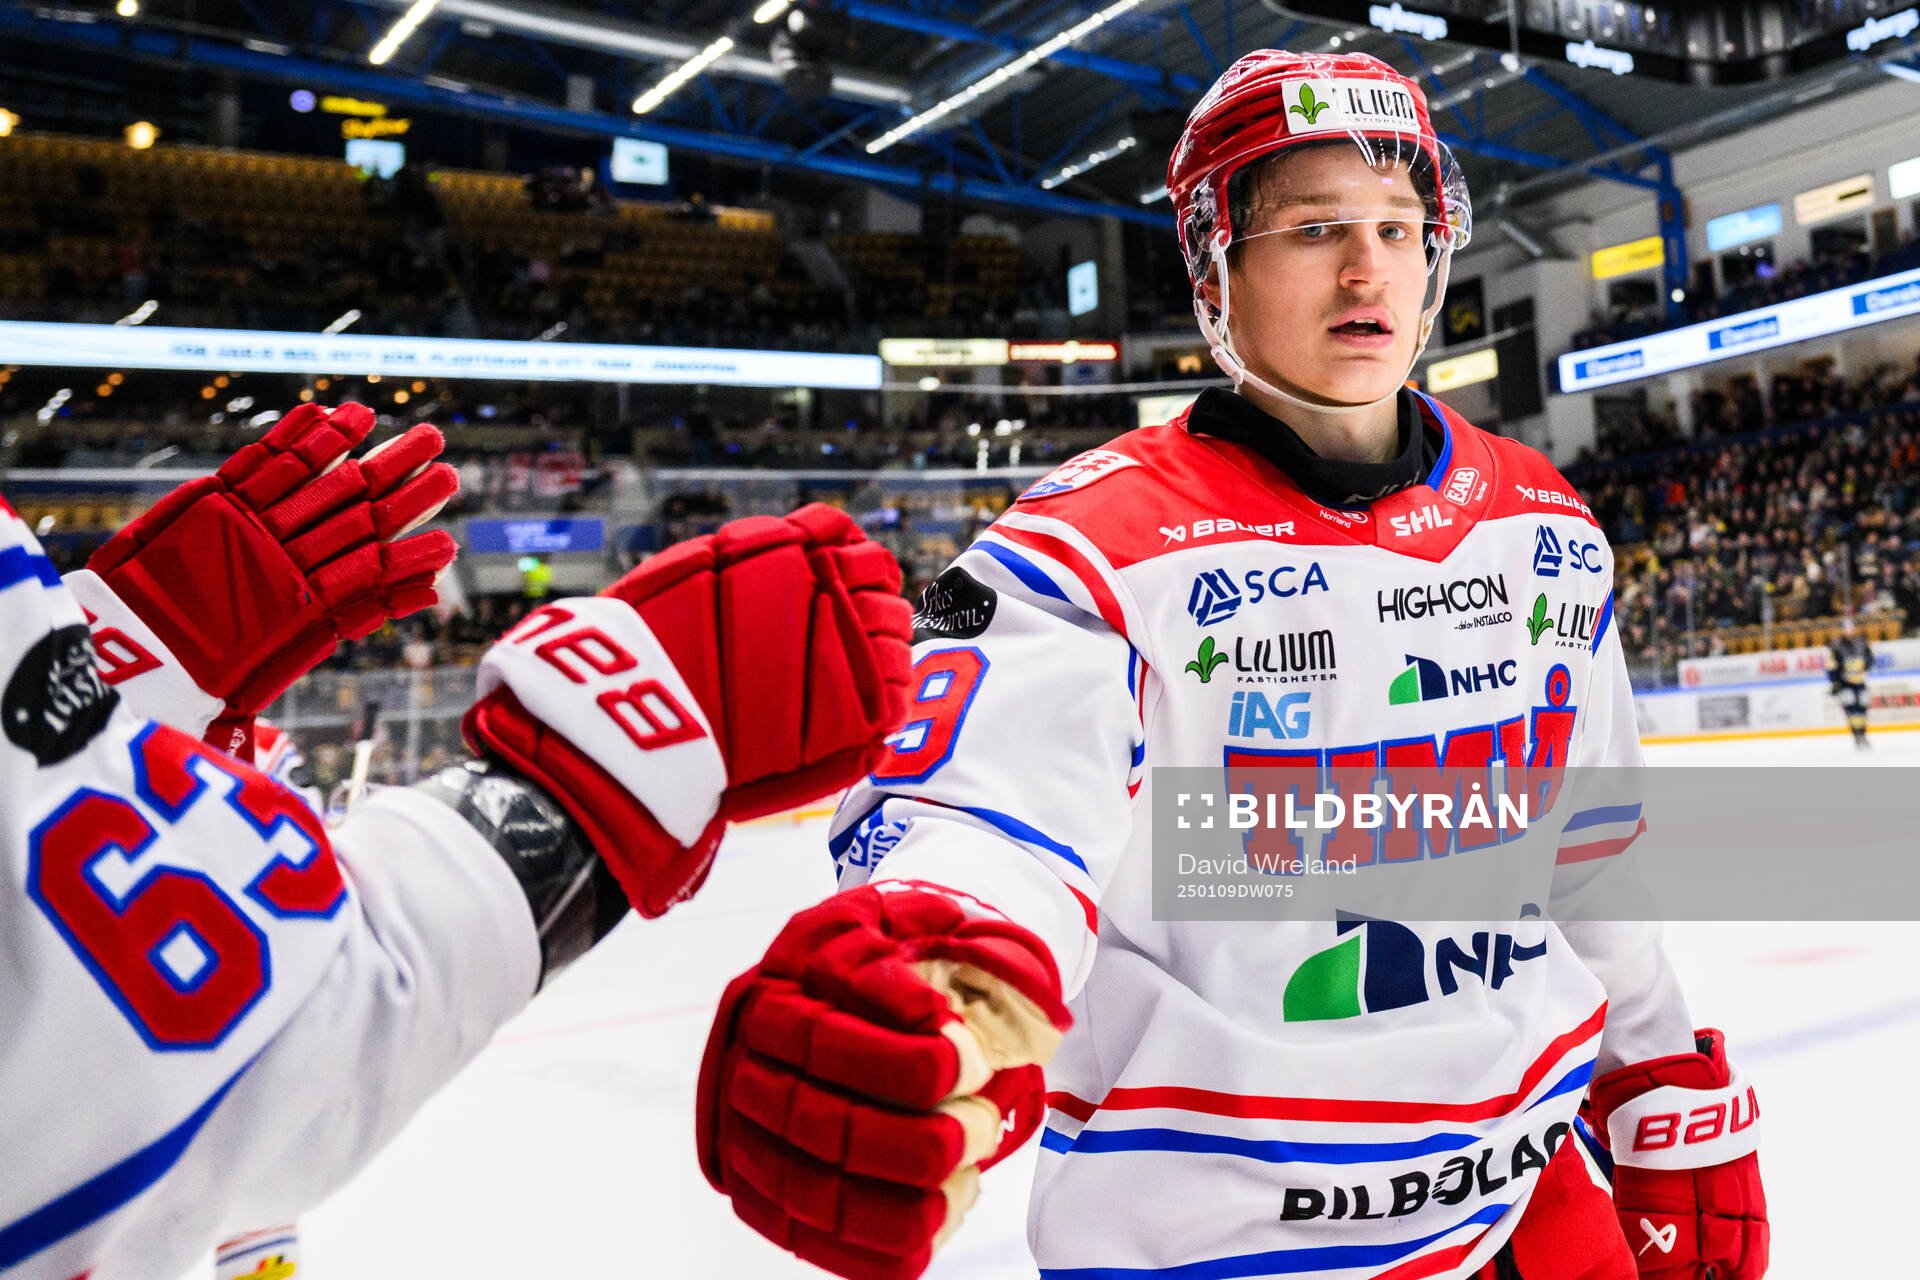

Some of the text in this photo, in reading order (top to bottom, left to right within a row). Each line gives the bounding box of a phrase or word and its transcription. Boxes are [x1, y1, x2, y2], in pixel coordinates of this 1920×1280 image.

[1332, 87, 1415, 120] ILIUM
[1390, 505, 1453, 537] SHL
[1245, 562, 1329, 604] SCA
[1377, 573, 1509, 623] HIGHCON
[1473, 611, 1512, 628] INSTALCO
[1235, 629, 1336, 673] LILIUM
[1238, 673, 1337, 684] FASTIGHETER
[1450, 659, 1517, 696] NHC
[26, 719, 349, 1053] 63
